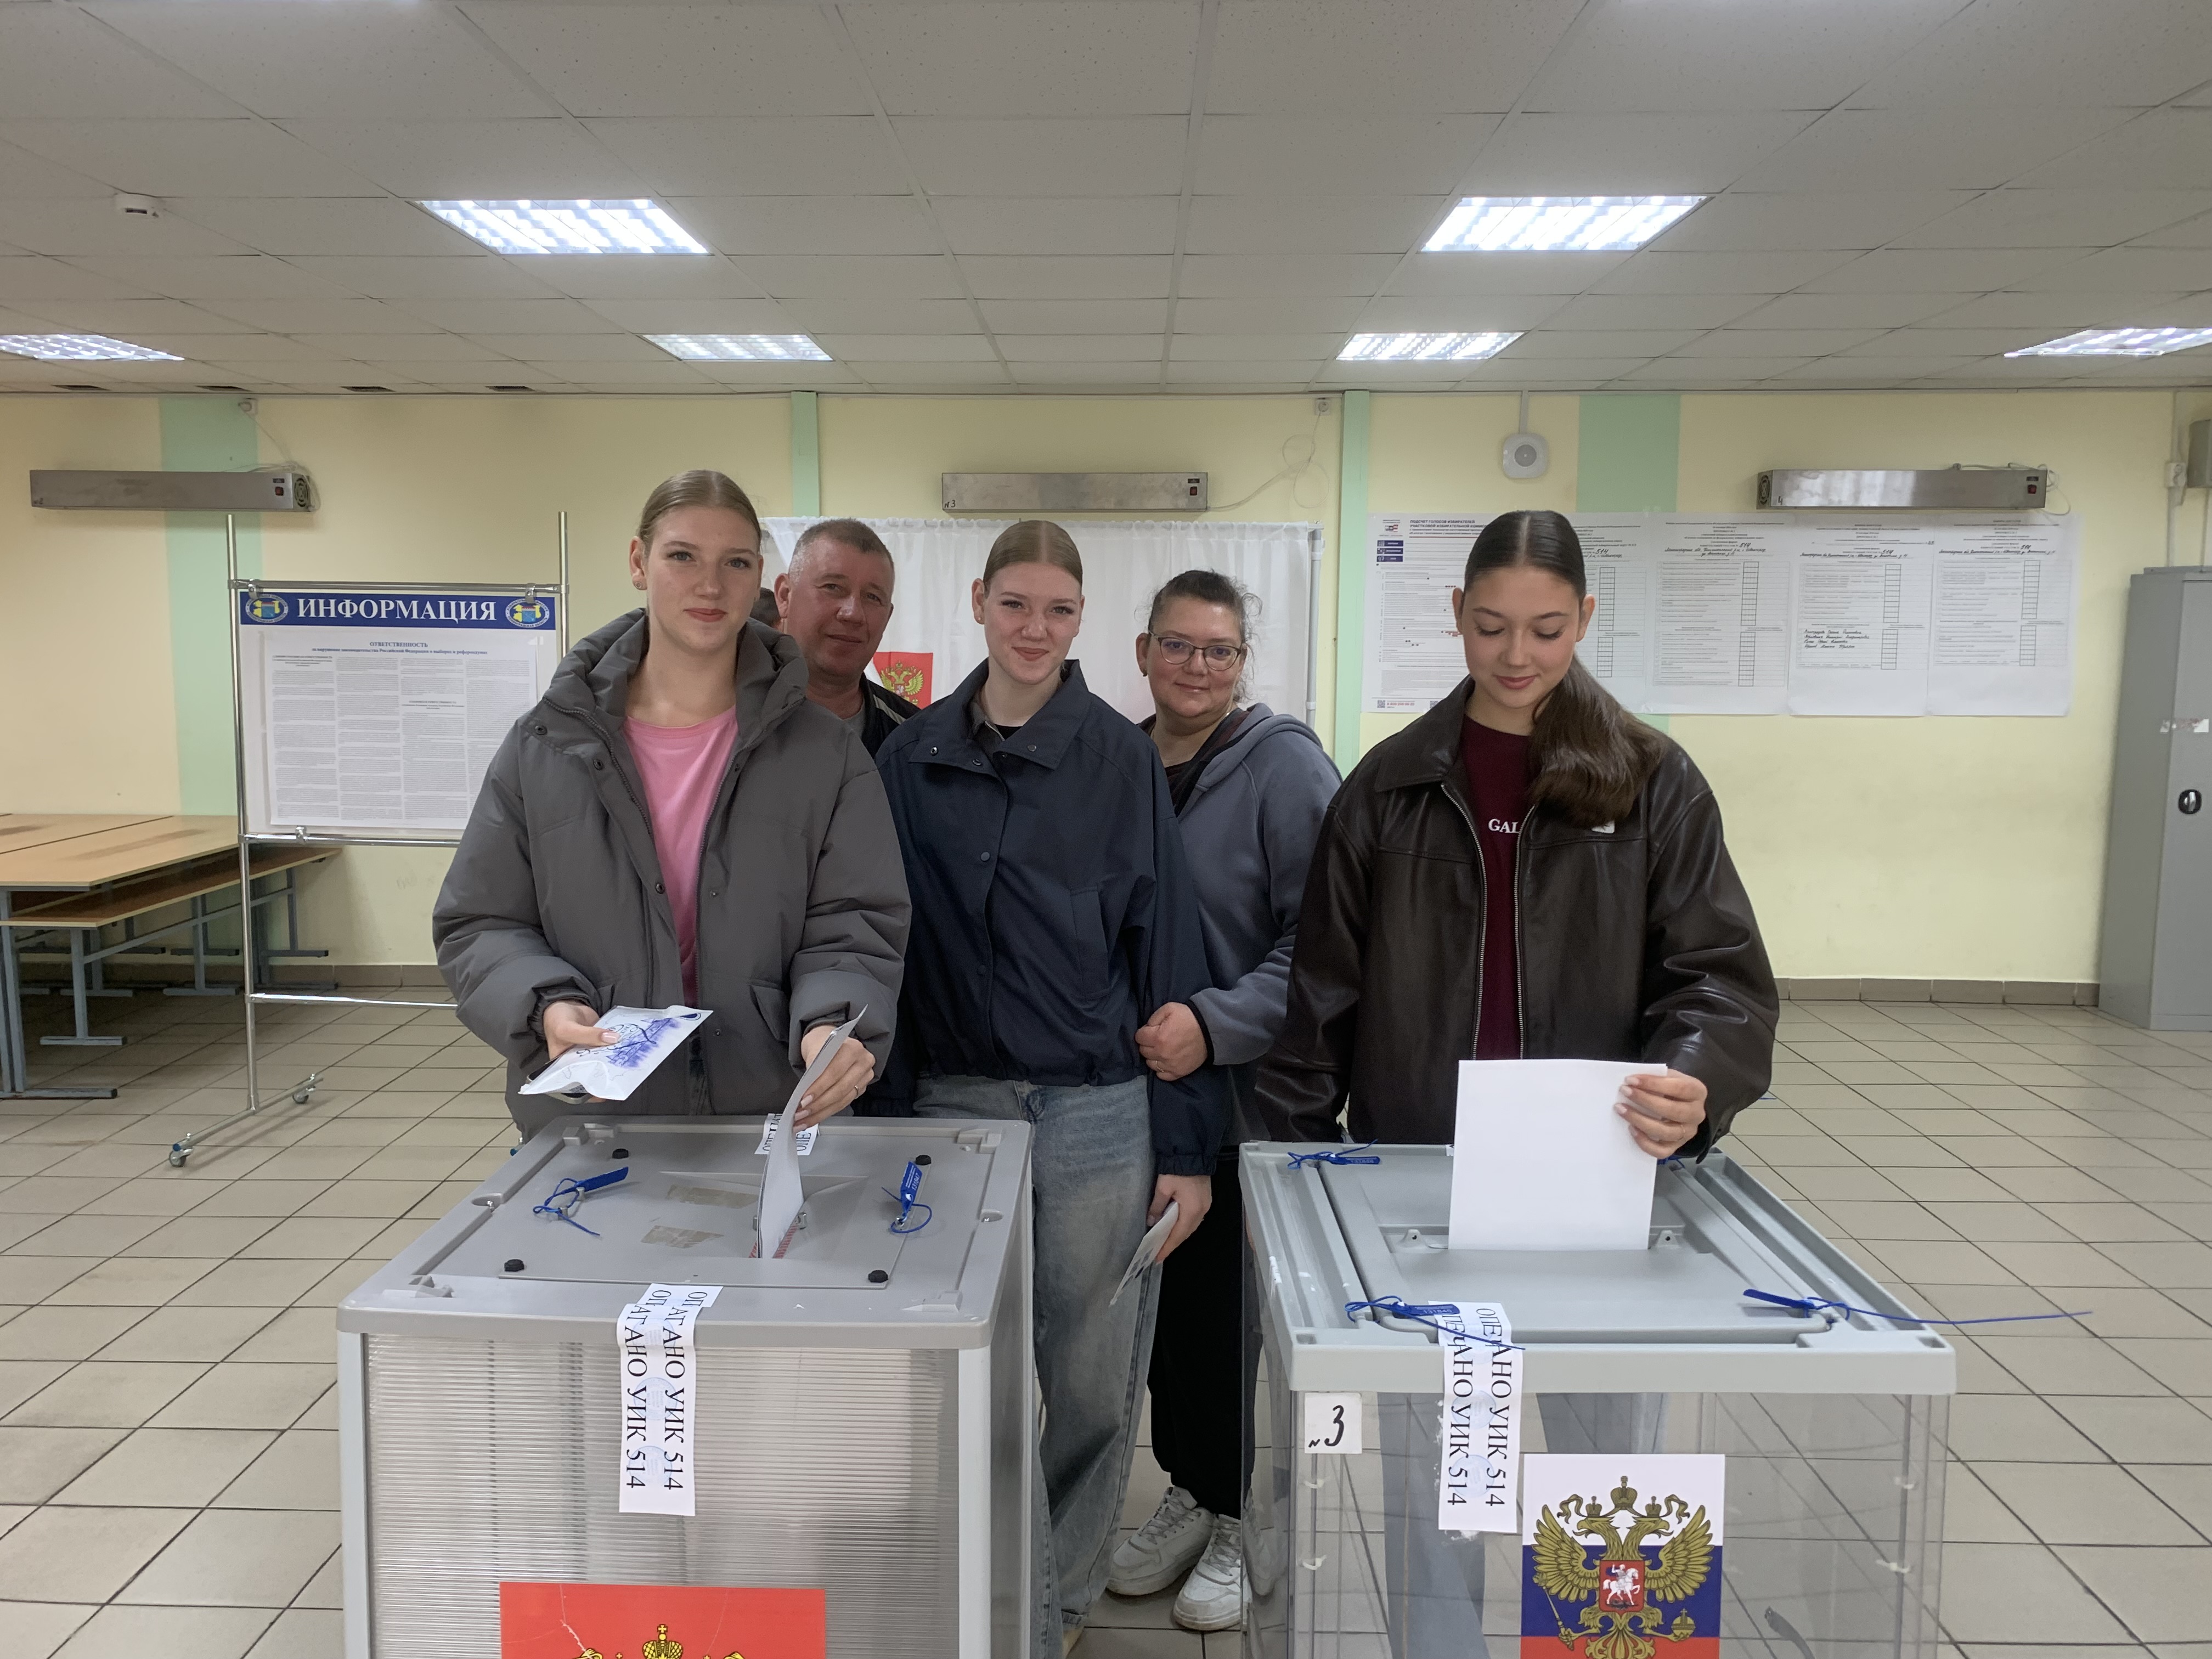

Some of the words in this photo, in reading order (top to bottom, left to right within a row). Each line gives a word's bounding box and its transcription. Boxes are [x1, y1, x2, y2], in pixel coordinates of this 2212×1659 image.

[297, 598, 497, 624] ИНФОРМАЦИЯ
[1488, 819, 1521, 834] GAL
[627, 1385, 647, 1442] УИК
[664, 1387, 685, 1444] УИК
[1449, 1403, 1471, 1458] УИК
[1487, 1404, 1510, 1460] УИК
[626, 1449, 646, 1489] 514
[664, 1451, 684, 1491] 514
[1447, 1466, 1468, 1506] 514
[1486, 1467, 1506, 1507] 514
